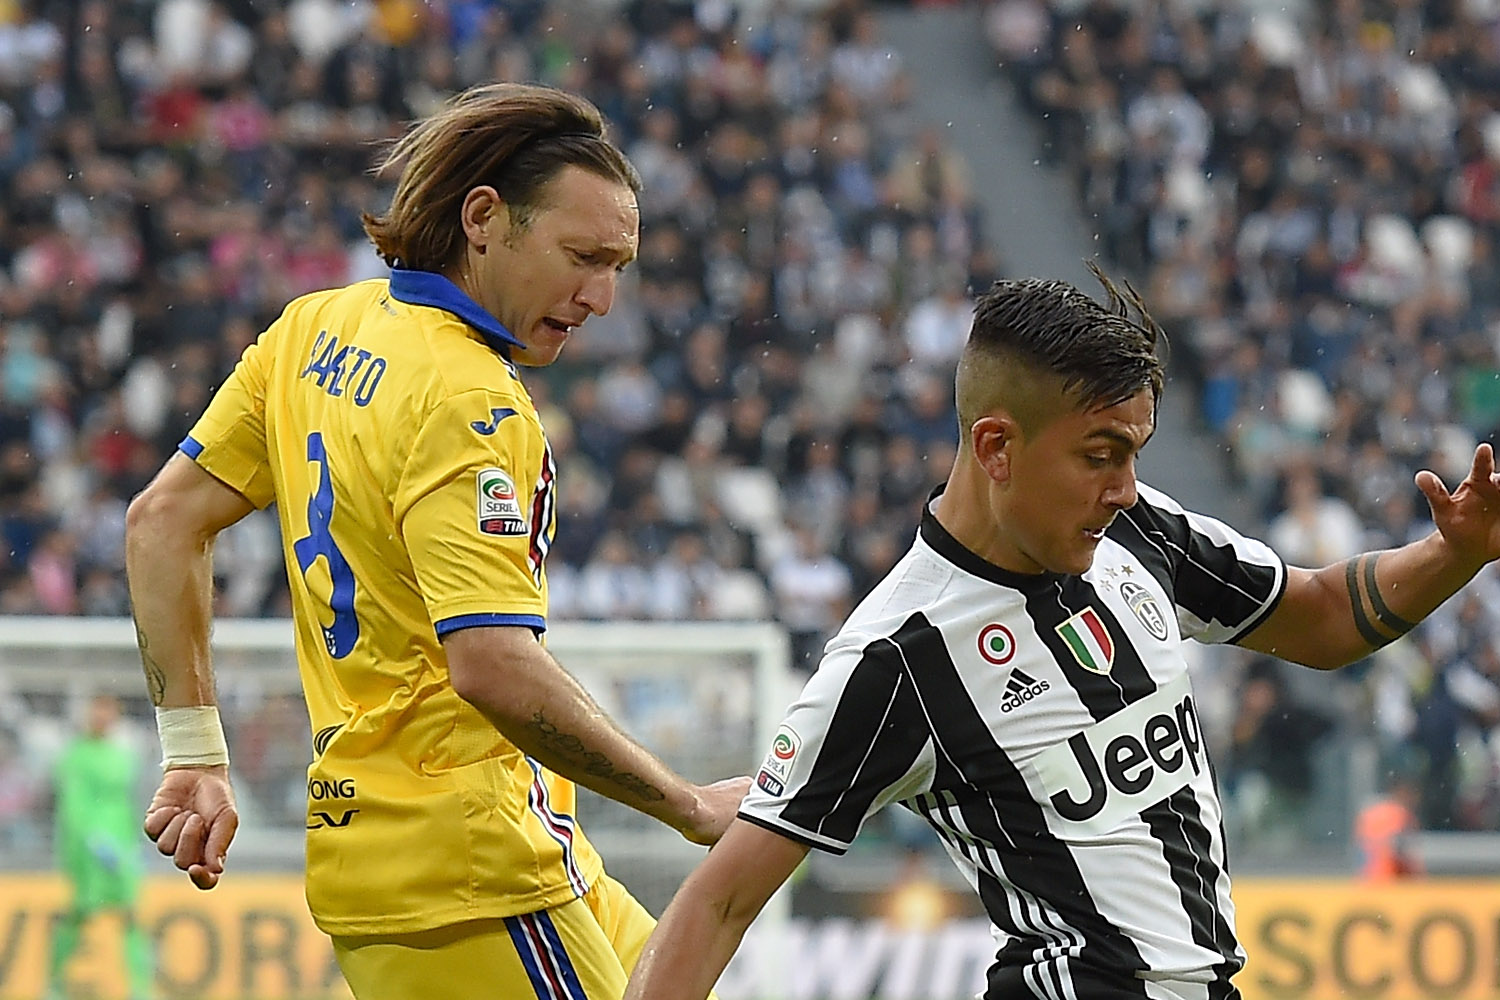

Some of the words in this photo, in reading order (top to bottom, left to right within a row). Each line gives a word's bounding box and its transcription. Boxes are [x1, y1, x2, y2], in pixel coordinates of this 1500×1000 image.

[504, 521, 527, 533] TIM
[1000, 680, 1051, 713] adidas
[1049, 695, 1200, 822] Jeep
[308, 777, 355, 800] ONG
[150, 908, 343, 1000] OR
